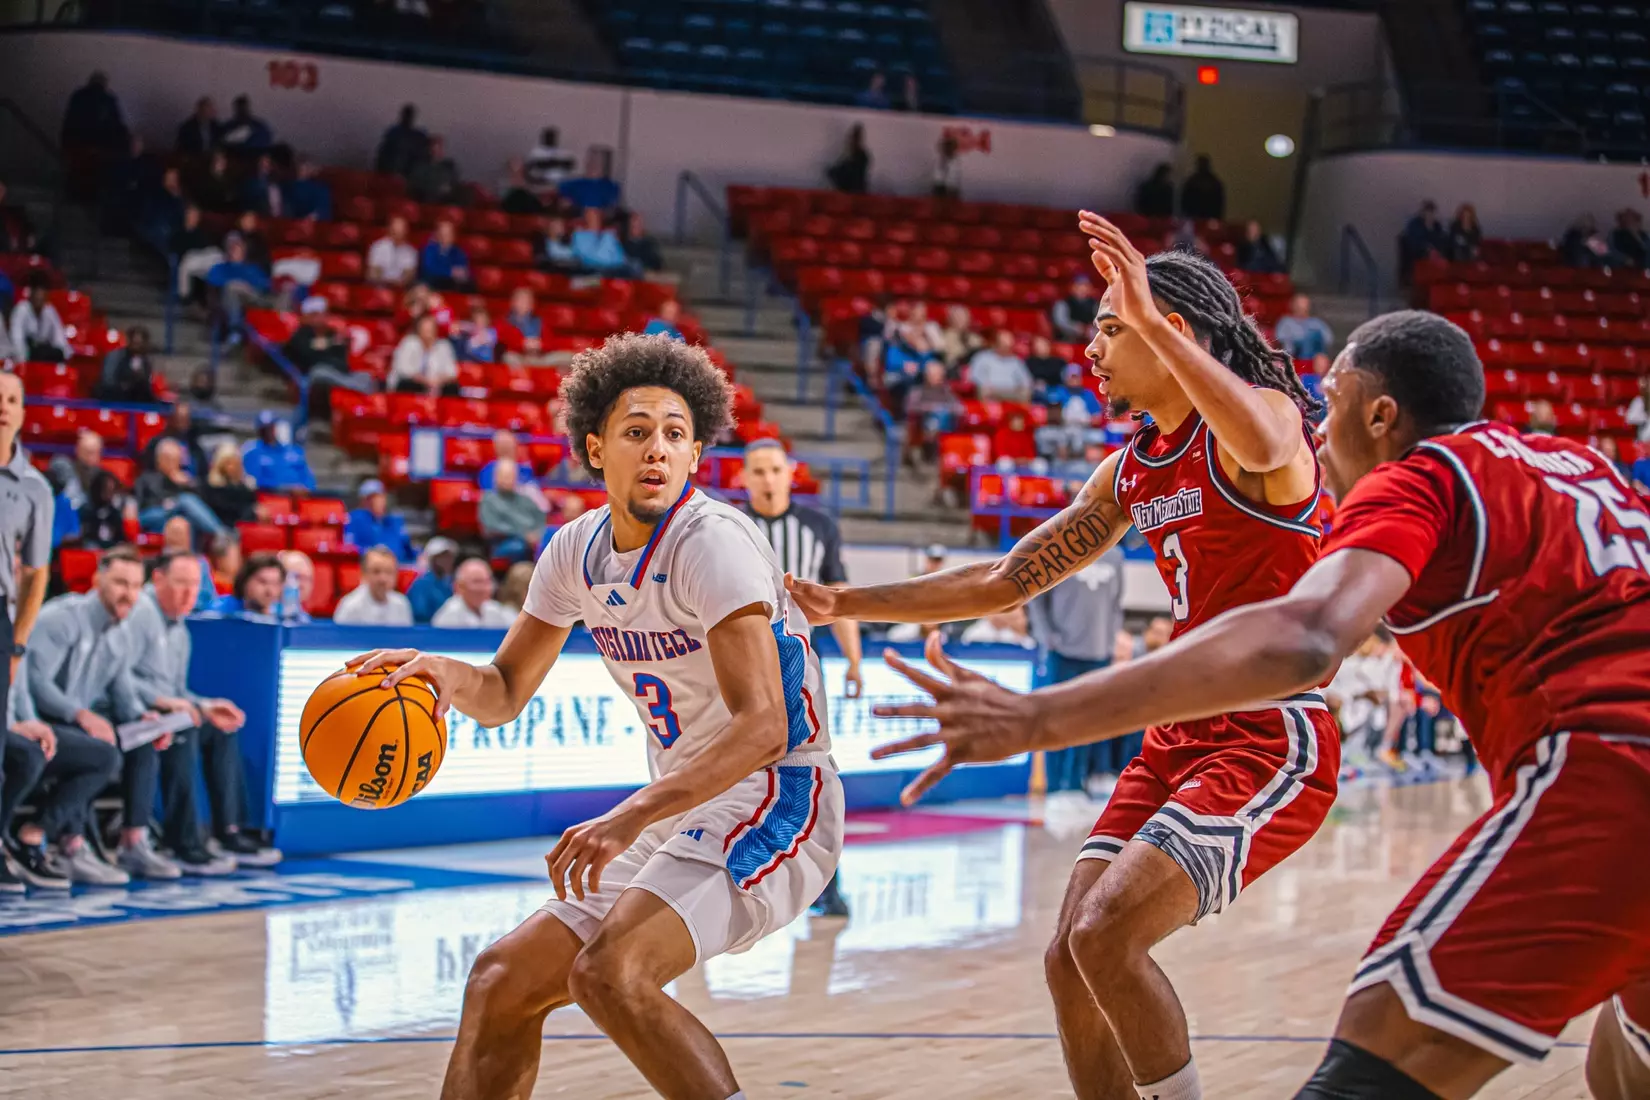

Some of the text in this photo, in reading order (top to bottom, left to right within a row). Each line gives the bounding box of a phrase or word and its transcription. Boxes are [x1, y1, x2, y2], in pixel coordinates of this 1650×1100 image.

[265, 60, 318, 93] 103
[1012, 512, 1111, 597] FEAR GOD
[1543, 476, 1650, 577] 25
[1162, 532, 1189, 621] 3
[632, 672, 682, 750] 3
